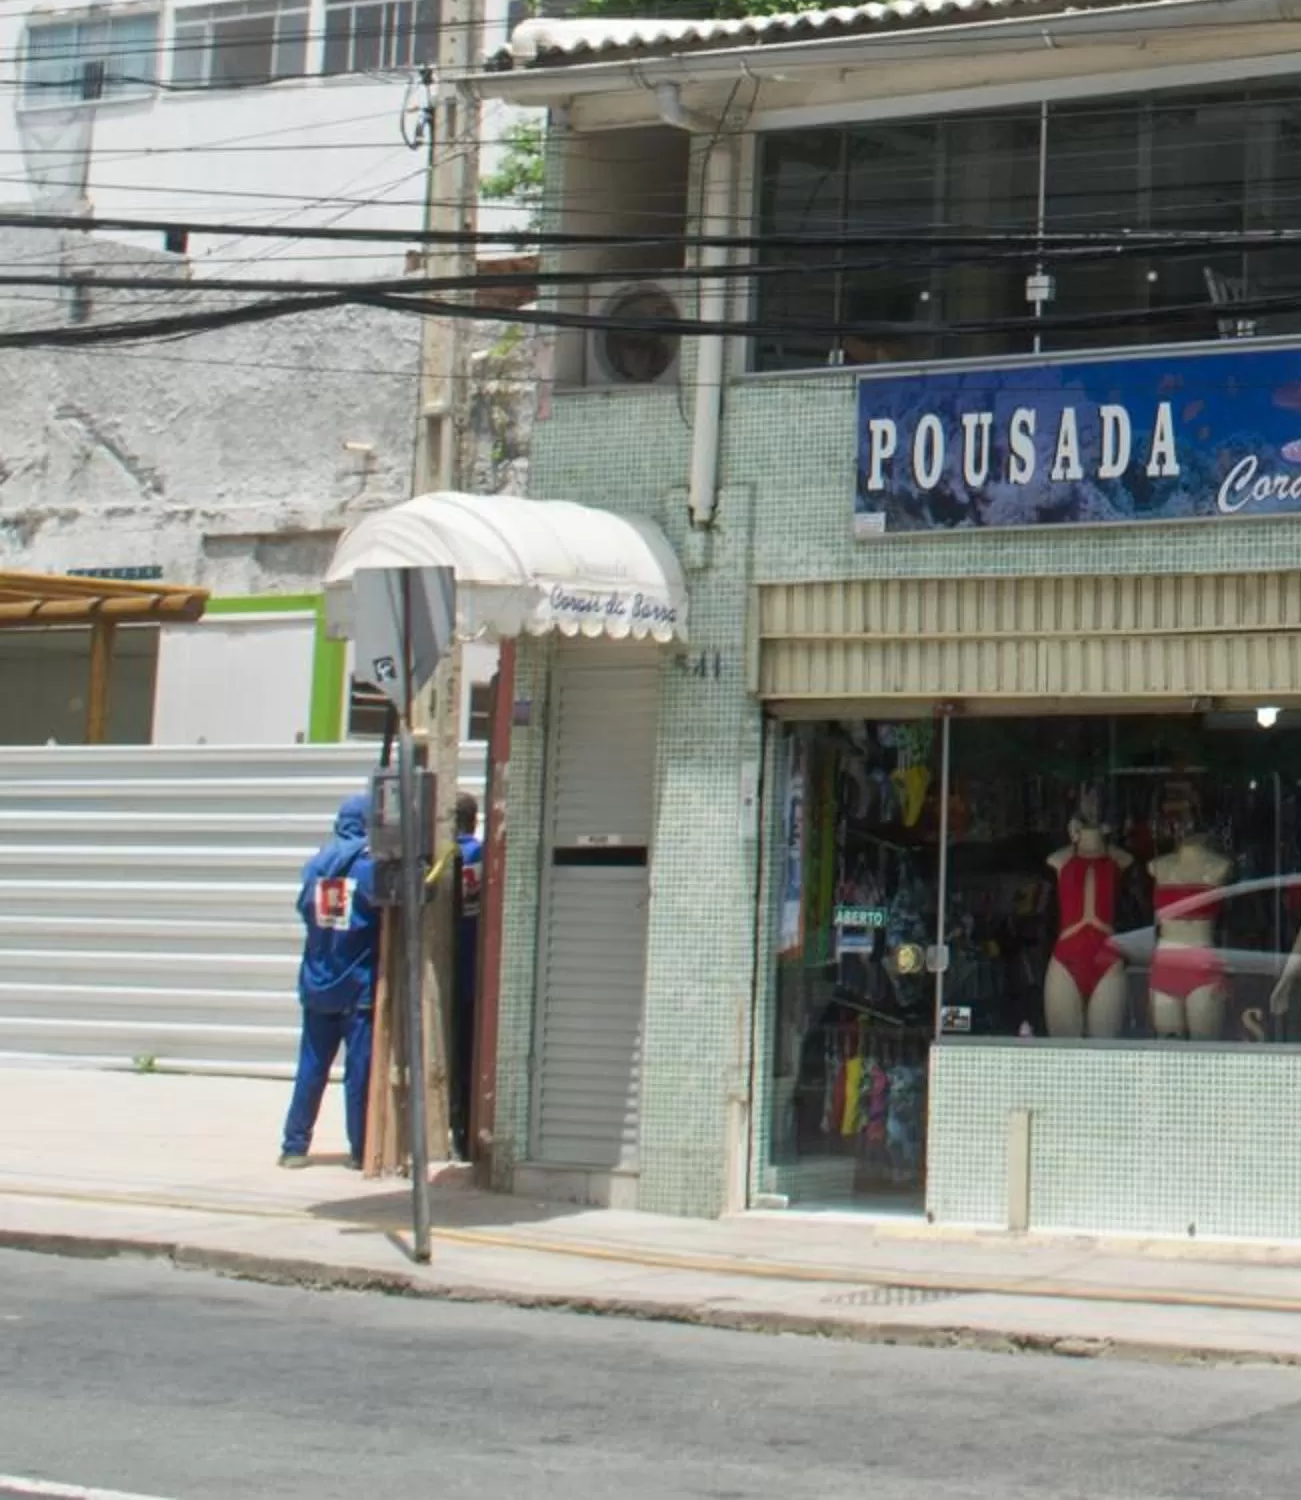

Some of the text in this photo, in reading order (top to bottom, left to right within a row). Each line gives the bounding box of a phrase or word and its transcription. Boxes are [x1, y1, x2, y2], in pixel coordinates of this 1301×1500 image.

[867, 402, 1181, 492] POUSADA
[550, 582, 678, 622] Corais da Barra
[834, 909, 883, 927] ABERTO
